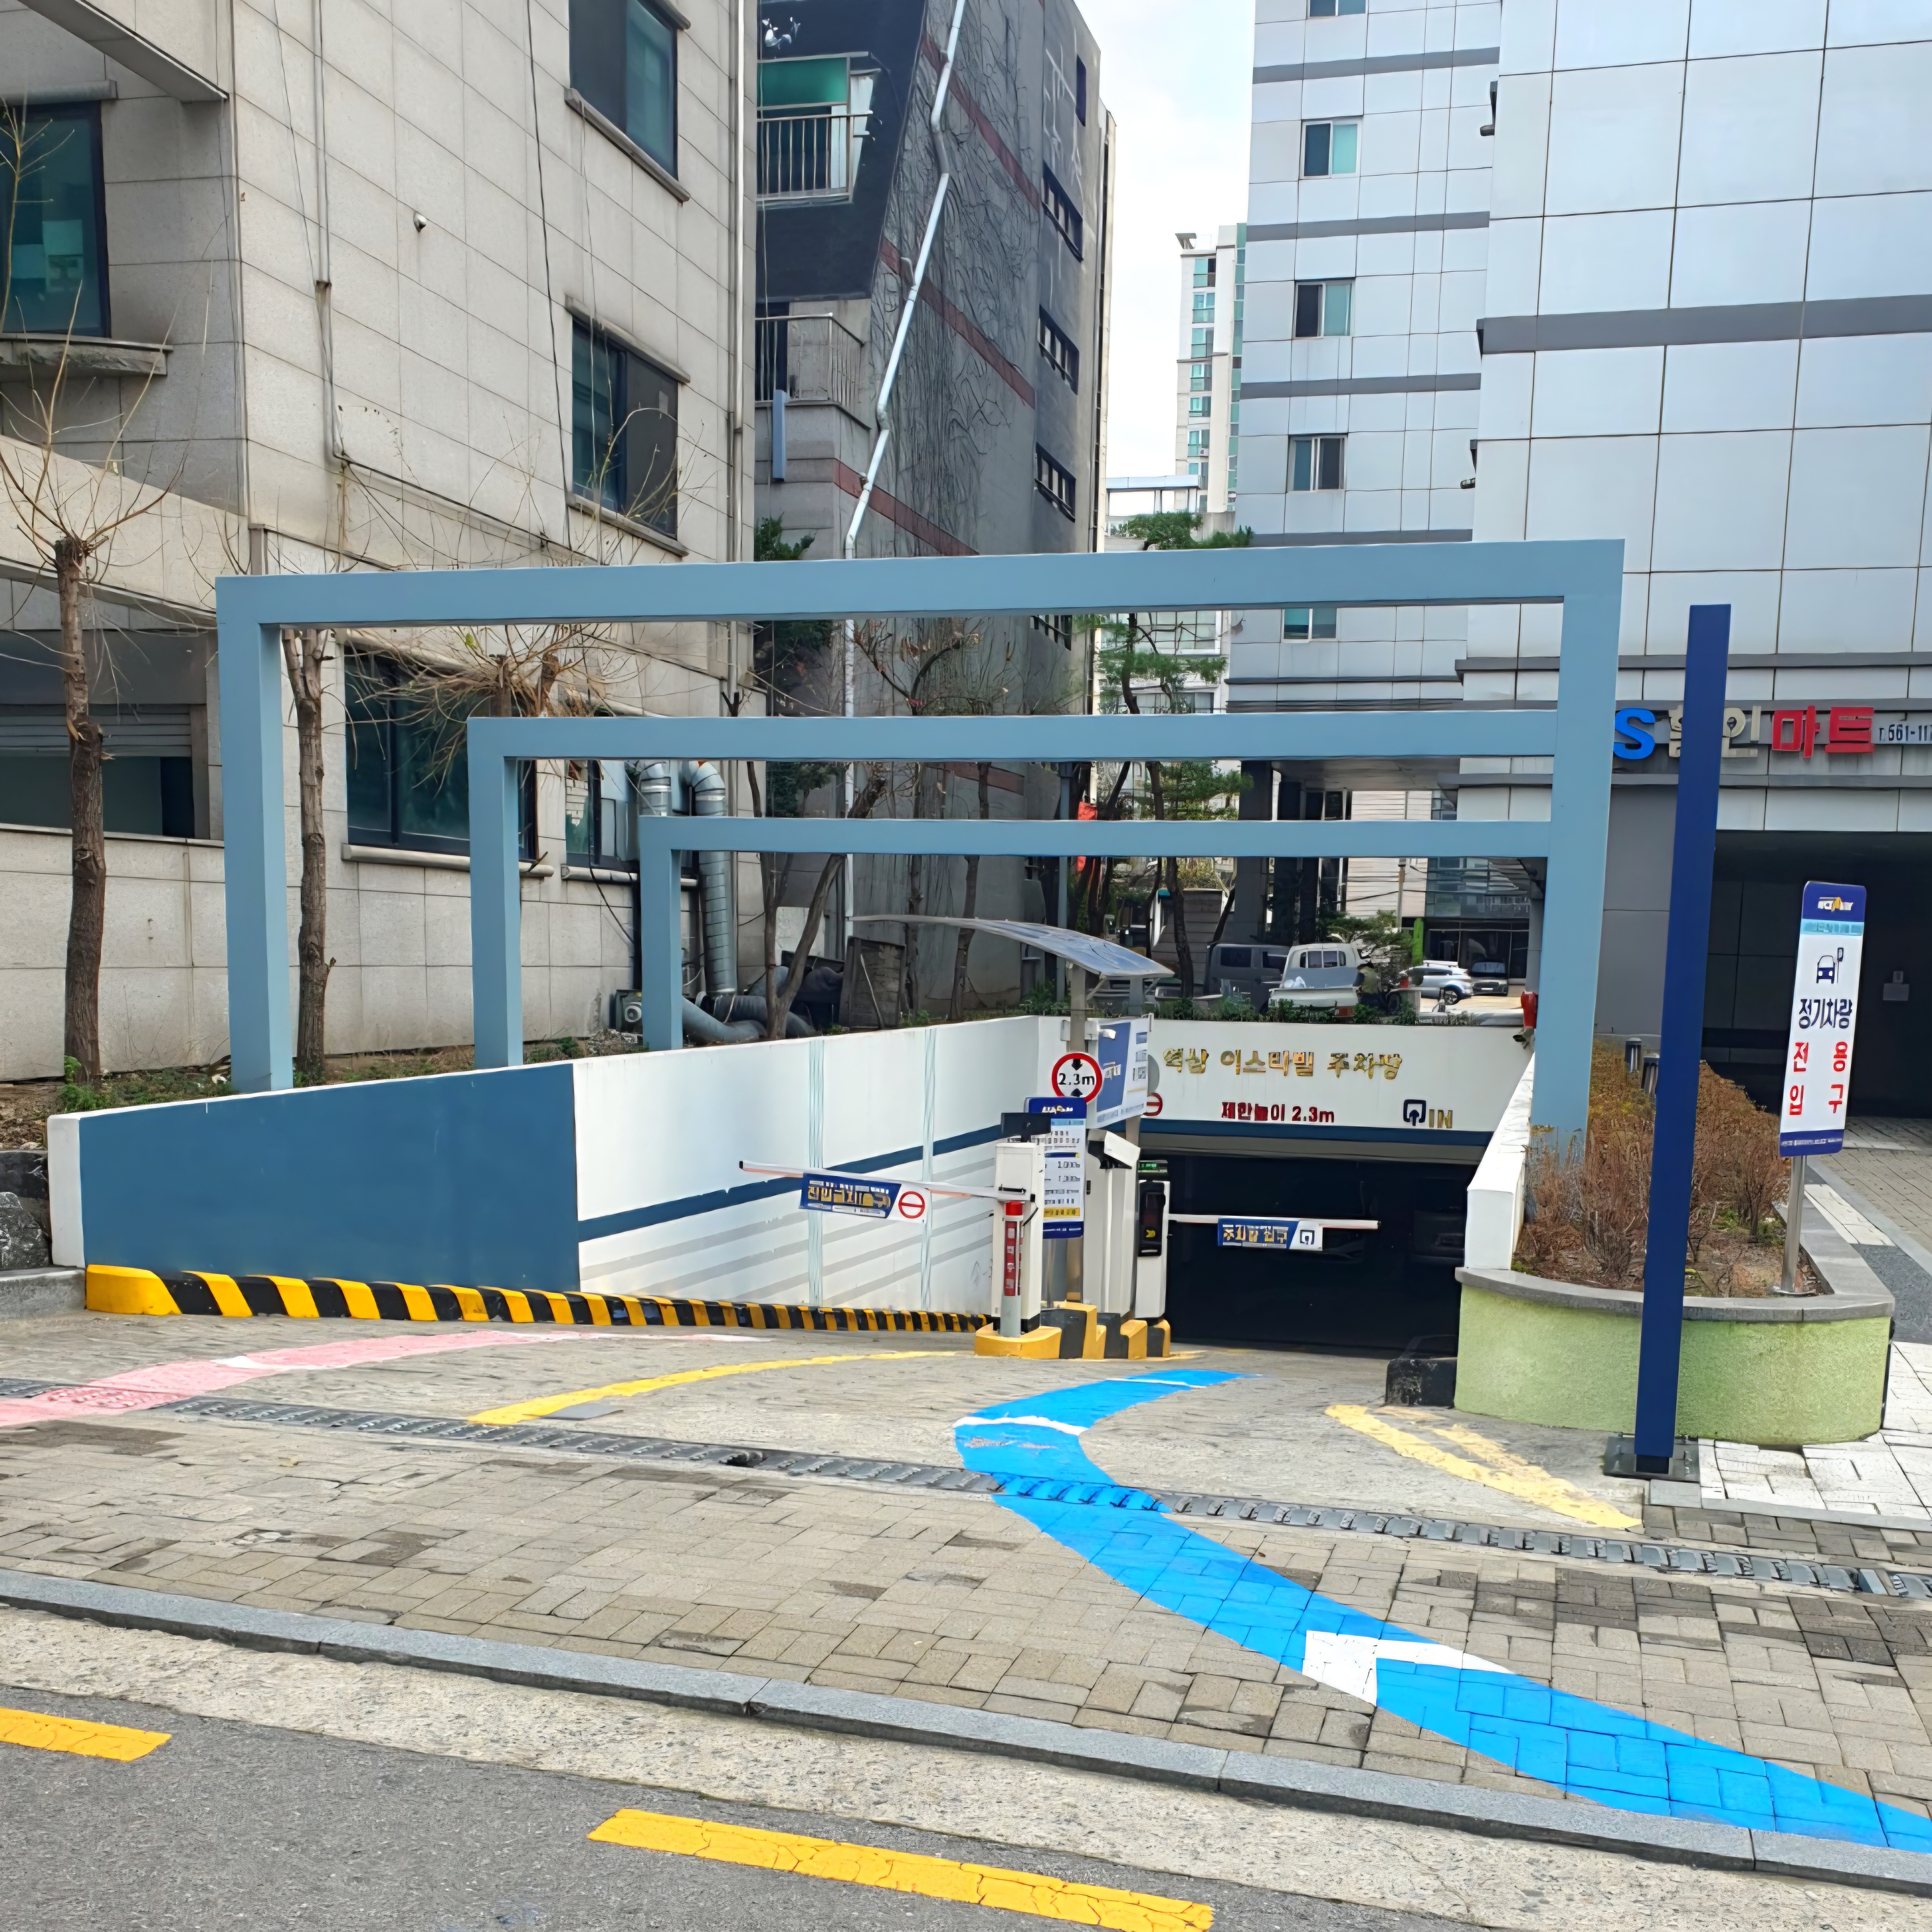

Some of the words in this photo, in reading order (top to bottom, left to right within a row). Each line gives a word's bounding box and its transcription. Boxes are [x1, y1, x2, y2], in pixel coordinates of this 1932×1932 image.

[1798, 998, 1853, 1030] 정기차량
[1327, 1053, 1403, 1080] 주차장
[1058, 1072, 1095, 1085] 2.3m
[1292, 1106, 1335, 1123] 2.3m
